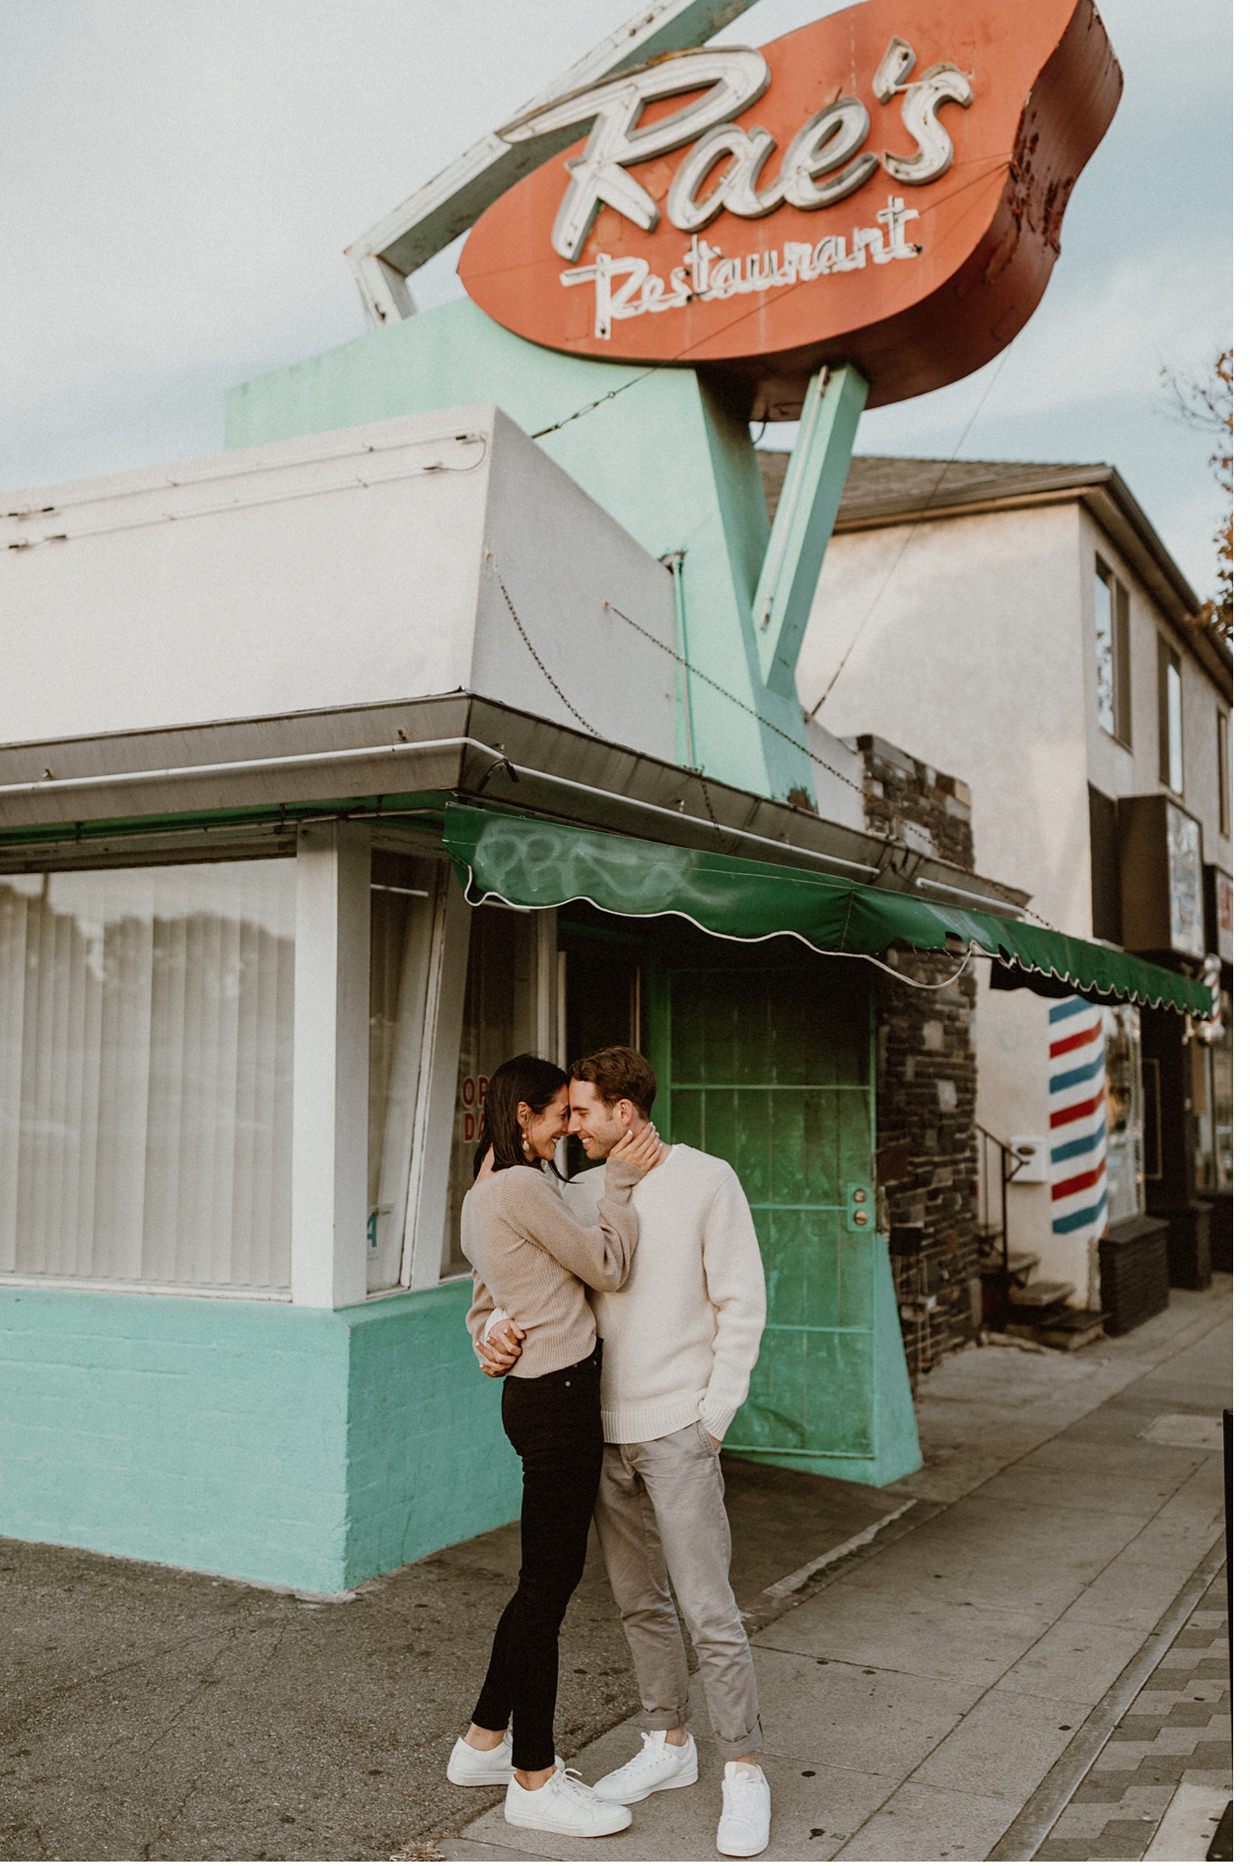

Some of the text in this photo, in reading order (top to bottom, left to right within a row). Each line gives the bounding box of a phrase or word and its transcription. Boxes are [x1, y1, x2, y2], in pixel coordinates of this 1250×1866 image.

[496, 37, 974, 262] Rae's
[561, 195, 920, 339] Restaurant
[462, 1075, 489, 1107] OP
